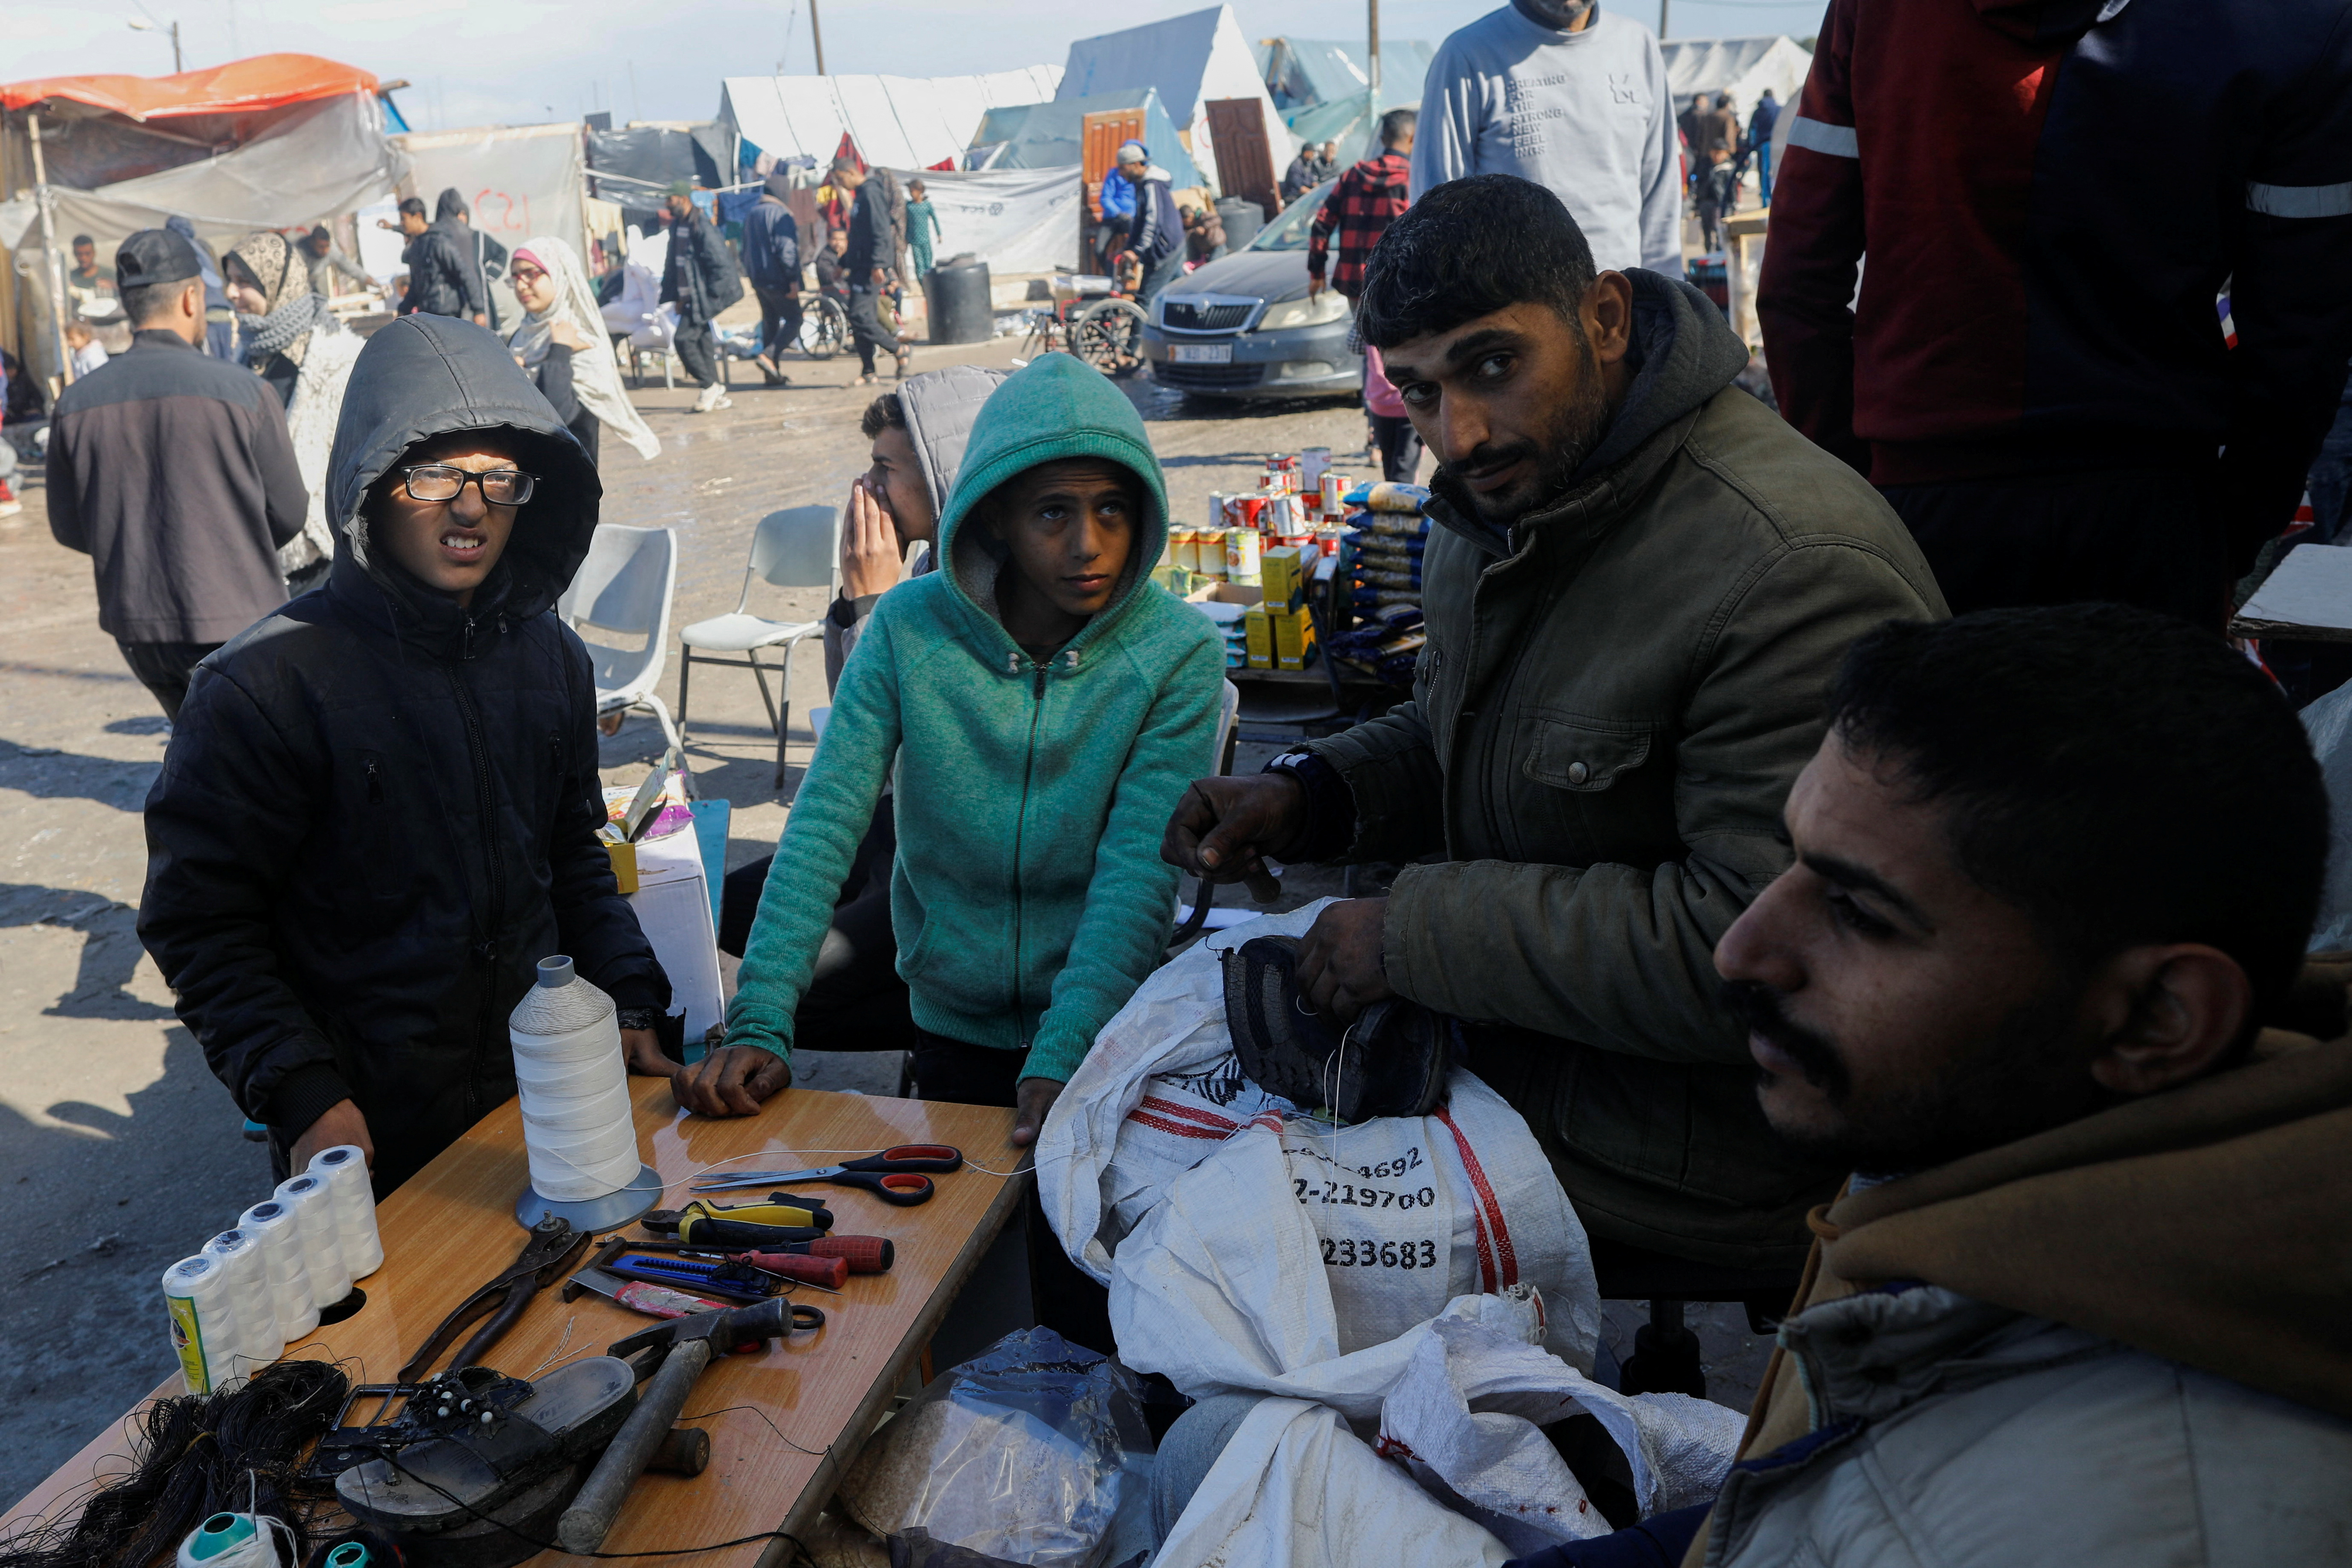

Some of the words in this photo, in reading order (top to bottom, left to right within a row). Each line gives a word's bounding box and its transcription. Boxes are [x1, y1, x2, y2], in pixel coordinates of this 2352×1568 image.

[1512, 123, 1541, 136] NEW
[1357, 1147, 1423, 1179] 4692
[1320, 1237, 1437, 1270] 233683
